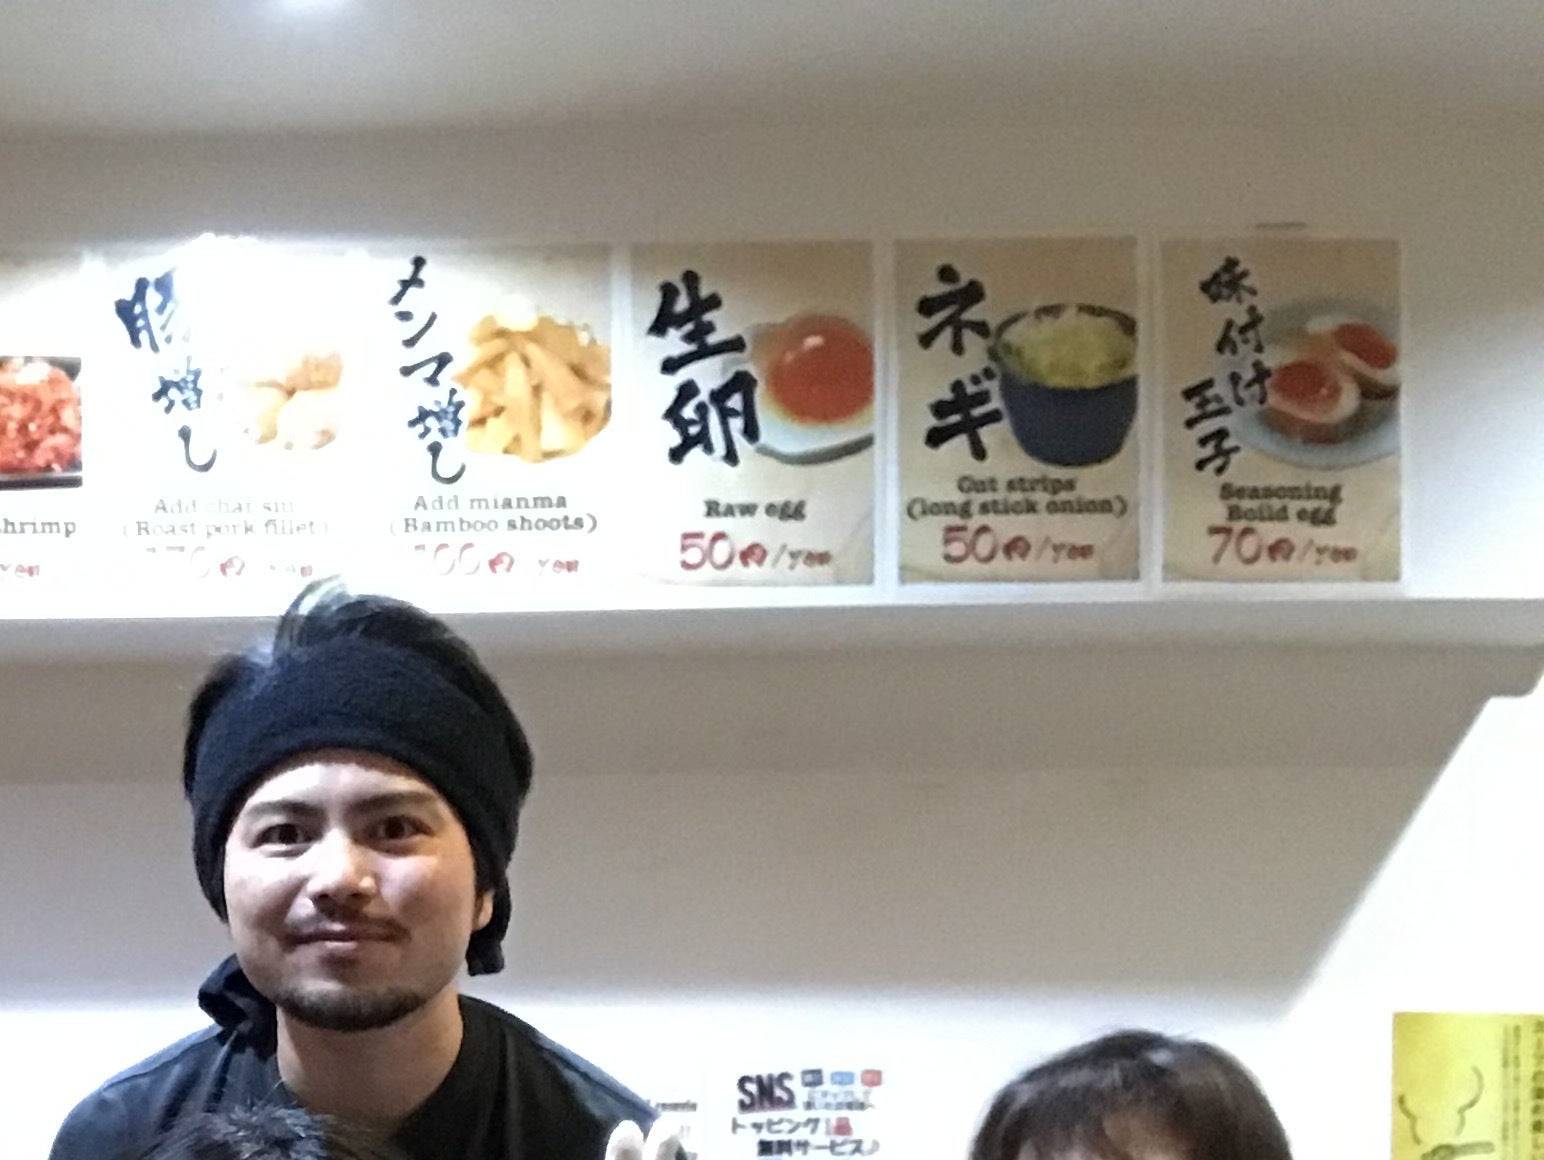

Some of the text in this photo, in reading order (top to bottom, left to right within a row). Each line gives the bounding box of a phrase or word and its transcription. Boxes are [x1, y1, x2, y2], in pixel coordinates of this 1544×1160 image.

[647, 269, 759, 467] 生卵
[917, 264, 1004, 462] ネギ
[1006, 476, 1076, 496] strips
[1220, 483, 1343, 505] Seasoning
[414, 495, 459, 511] Add
[507, 513, 597, 534] shoots)
[737, 1072, 797, 1112] SNS
